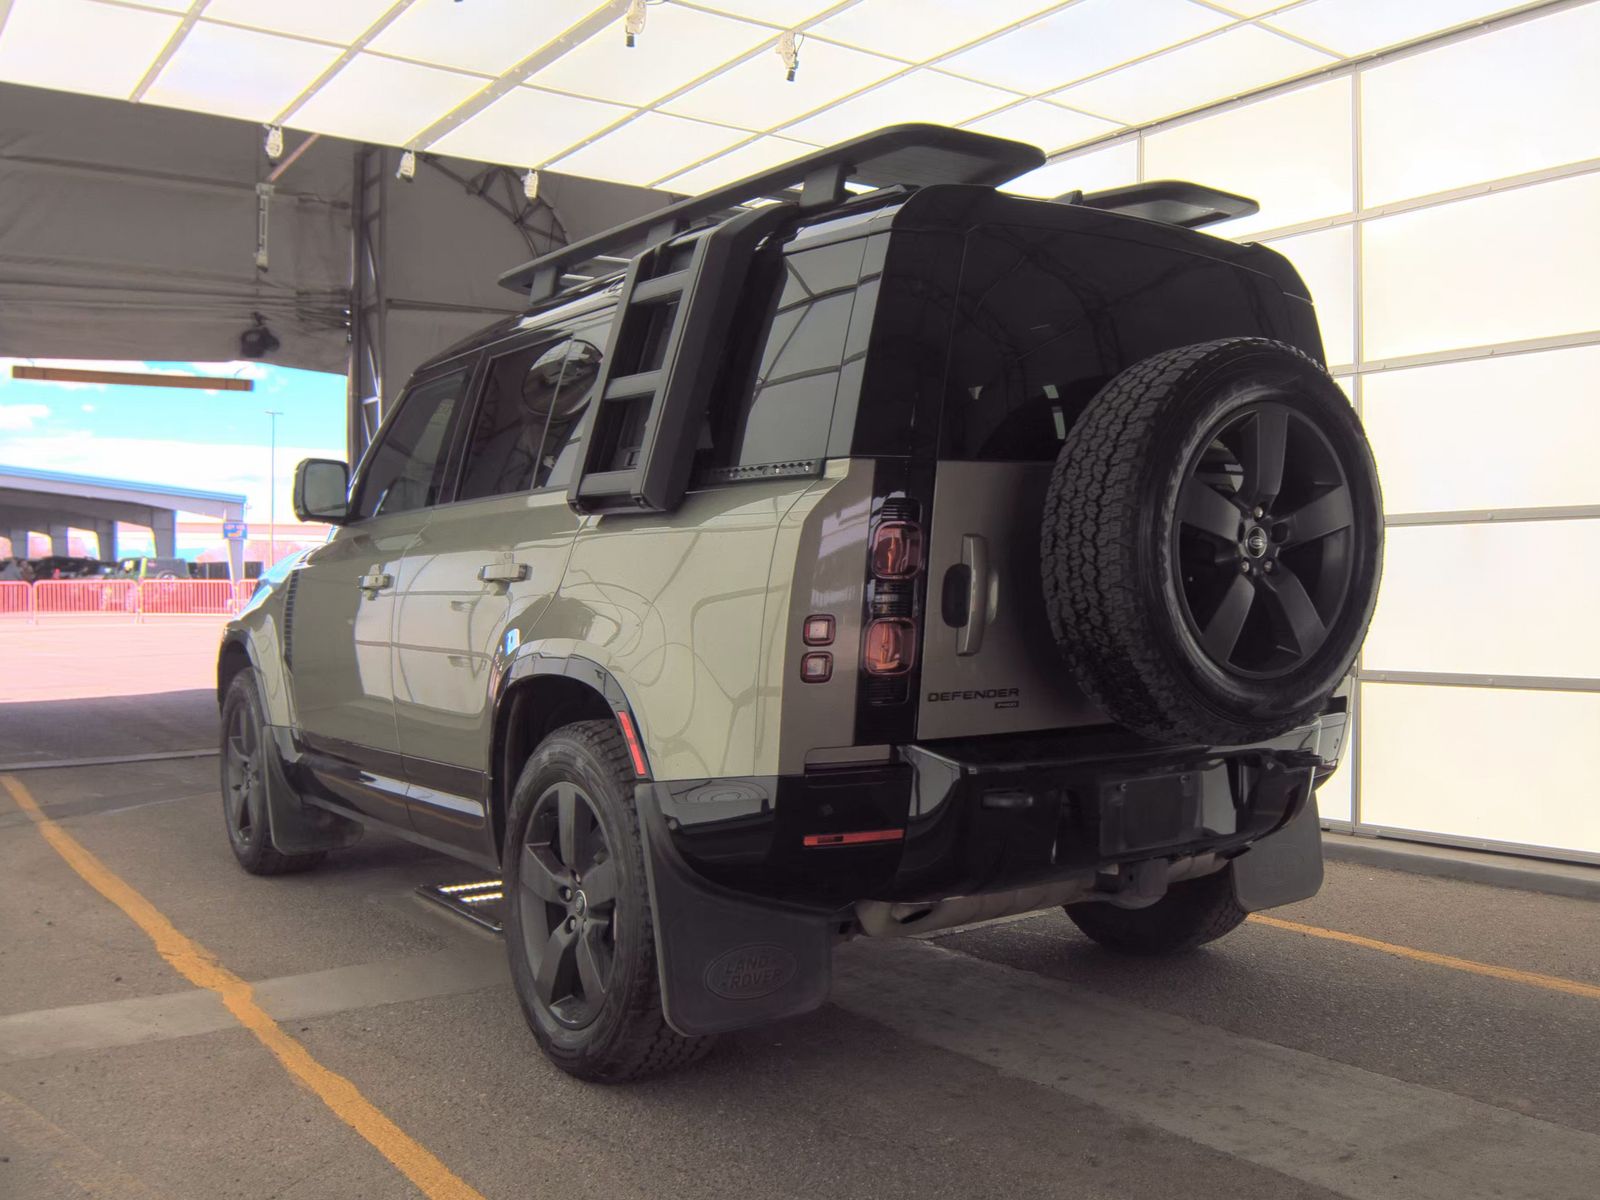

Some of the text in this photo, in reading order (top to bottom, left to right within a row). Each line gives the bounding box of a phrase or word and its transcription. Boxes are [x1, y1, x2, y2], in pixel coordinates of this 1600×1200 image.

[927, 687, 1019, 702] DEFENDER
[725, 954, 769, 974] LAND
[728, 968, 783, 988] ROVER
